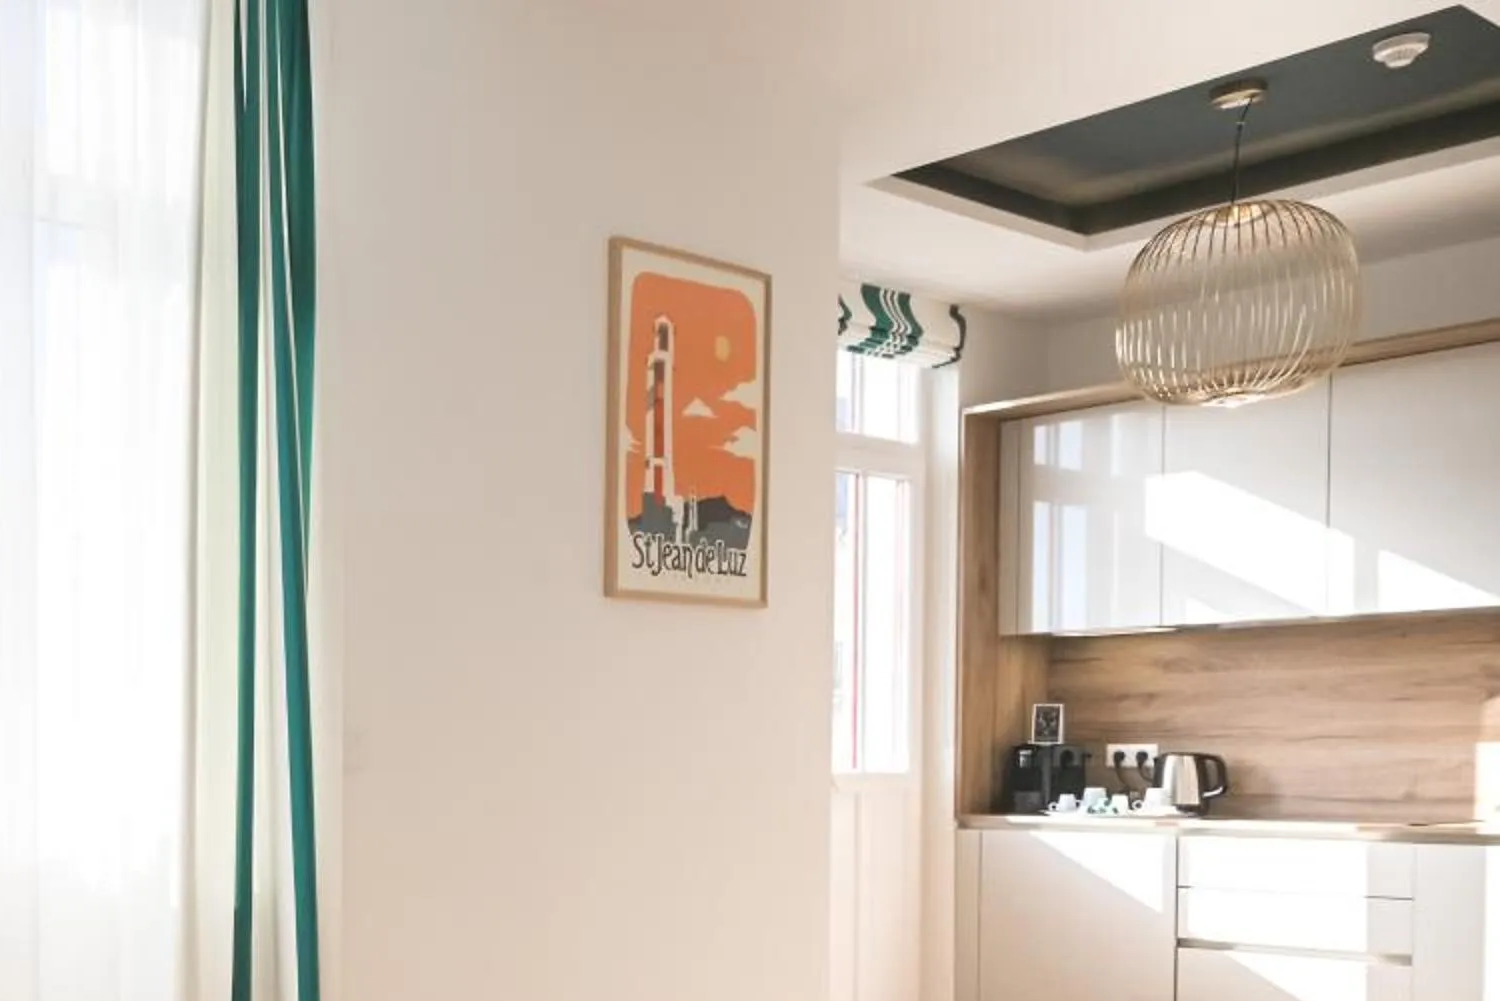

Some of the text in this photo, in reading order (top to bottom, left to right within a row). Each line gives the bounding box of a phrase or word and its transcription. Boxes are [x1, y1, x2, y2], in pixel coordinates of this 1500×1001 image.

[652, 533, 693, 579] Jean
[695, 537, 715, 575] de
[716, 539, 747, 577] Luz
